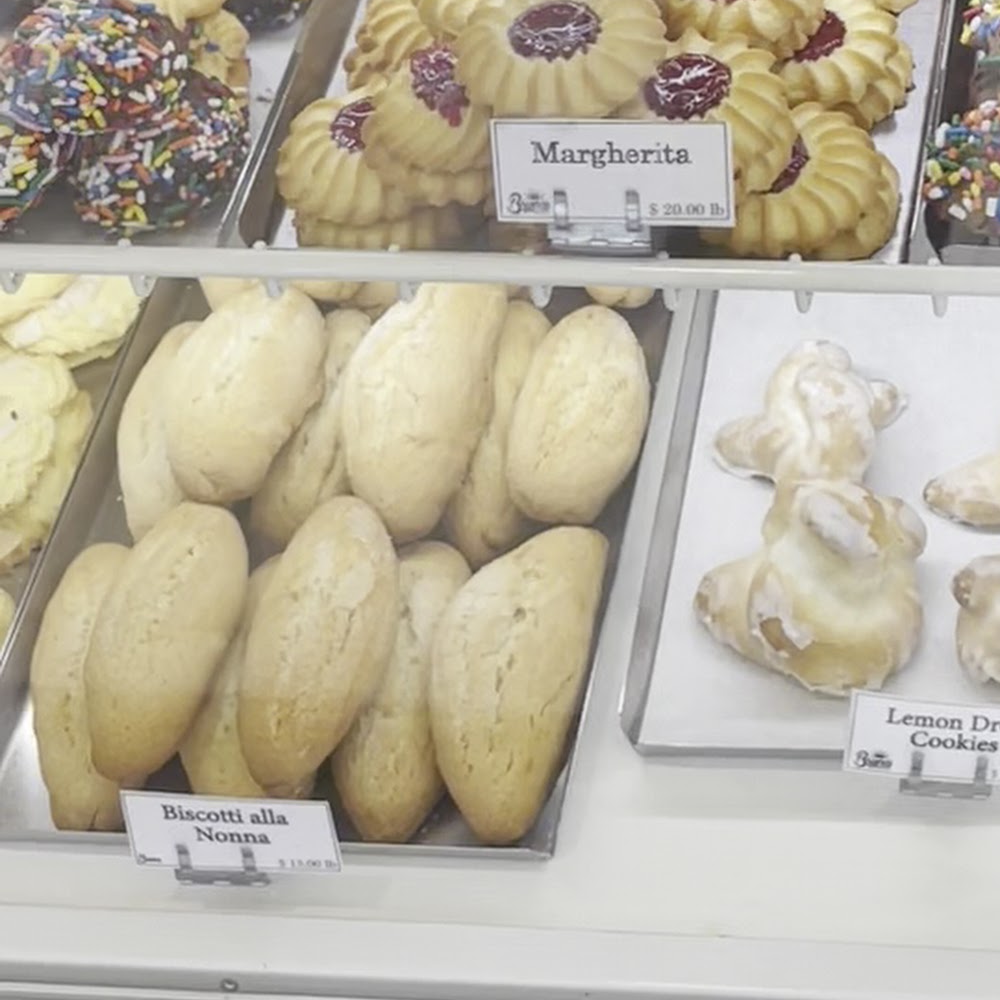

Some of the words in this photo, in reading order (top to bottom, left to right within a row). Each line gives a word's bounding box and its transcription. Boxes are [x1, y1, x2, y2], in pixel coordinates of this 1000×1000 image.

[530, 141, 692, 169] Margherita
[650, 203, 659, 216] $
[664, 202, 705, 216] 20.00
[710, 202, 725, 216] lb
[886, 707, 963, 730] Lemon
[910, 731, 999, 752] Cookies
[161, 804, 244, 824] Biscotti
[250, 809, 289, 825] alla
[194, 826, 271, 844] Nonna
